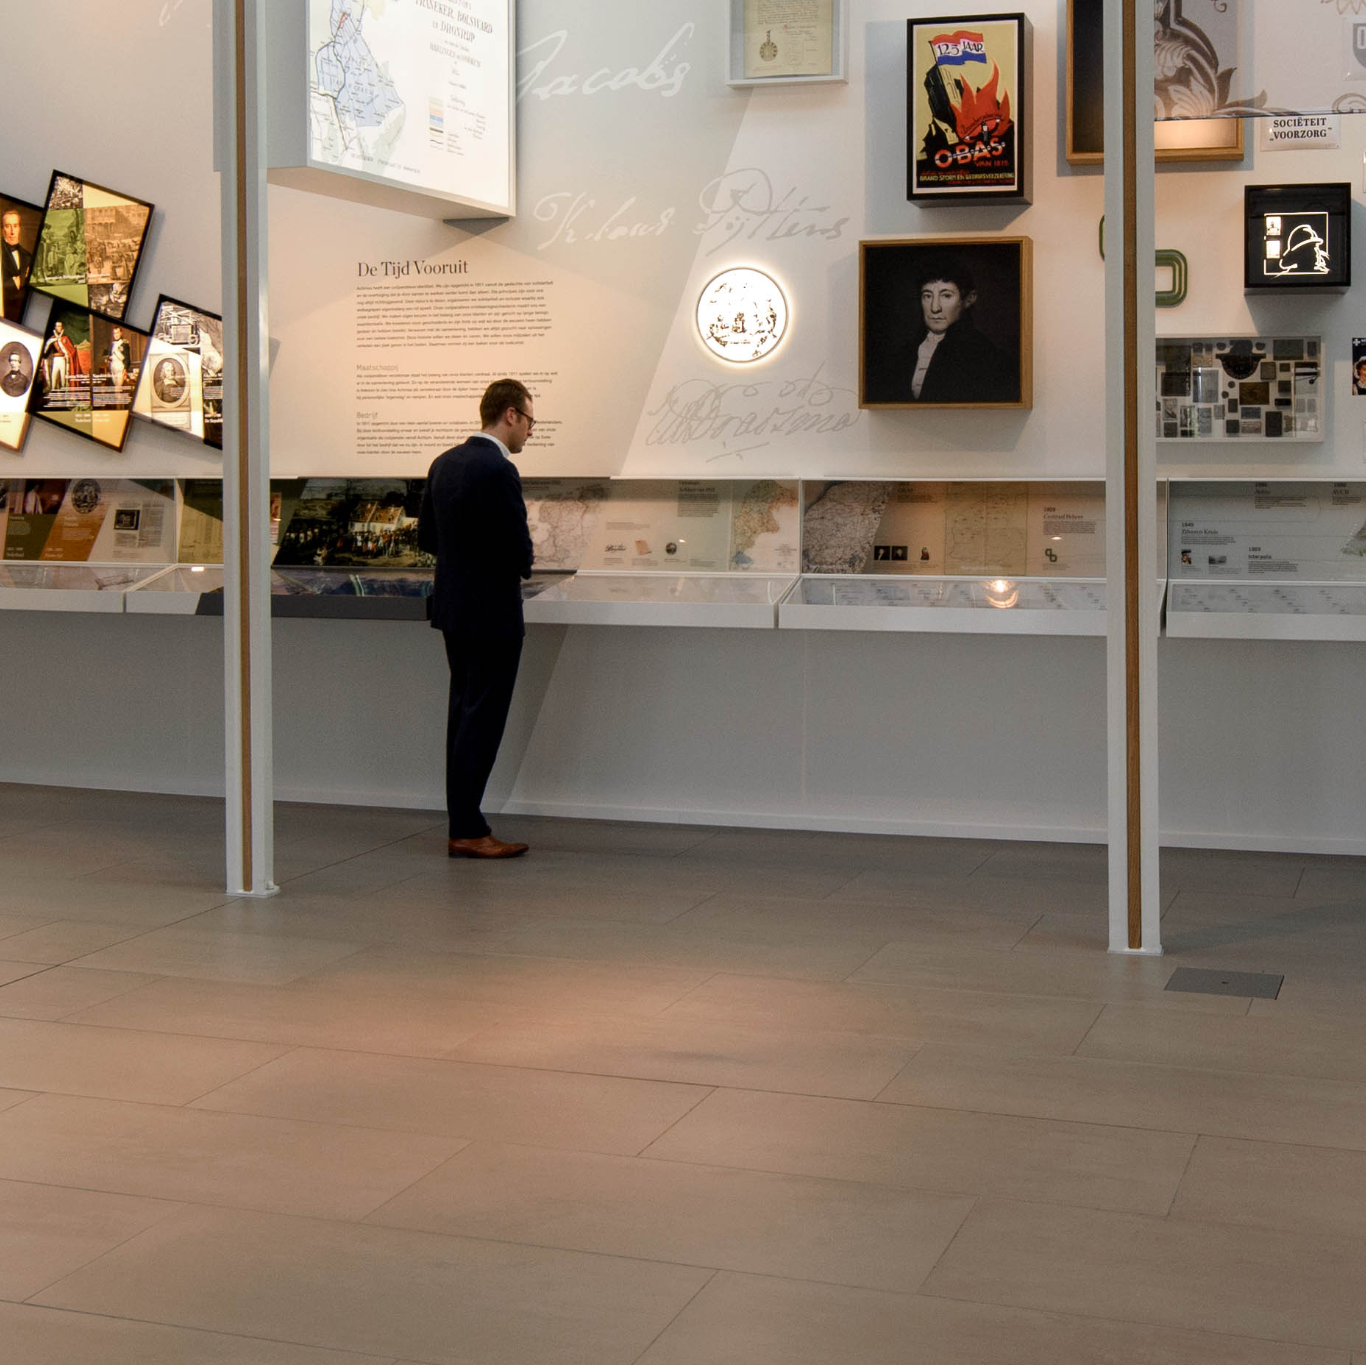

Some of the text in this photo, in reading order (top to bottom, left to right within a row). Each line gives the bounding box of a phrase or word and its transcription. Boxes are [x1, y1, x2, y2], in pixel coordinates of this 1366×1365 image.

[358, 260, 469, 279] De Tijd Vooruit
[357, 412, 378, 420] Bedrijf
